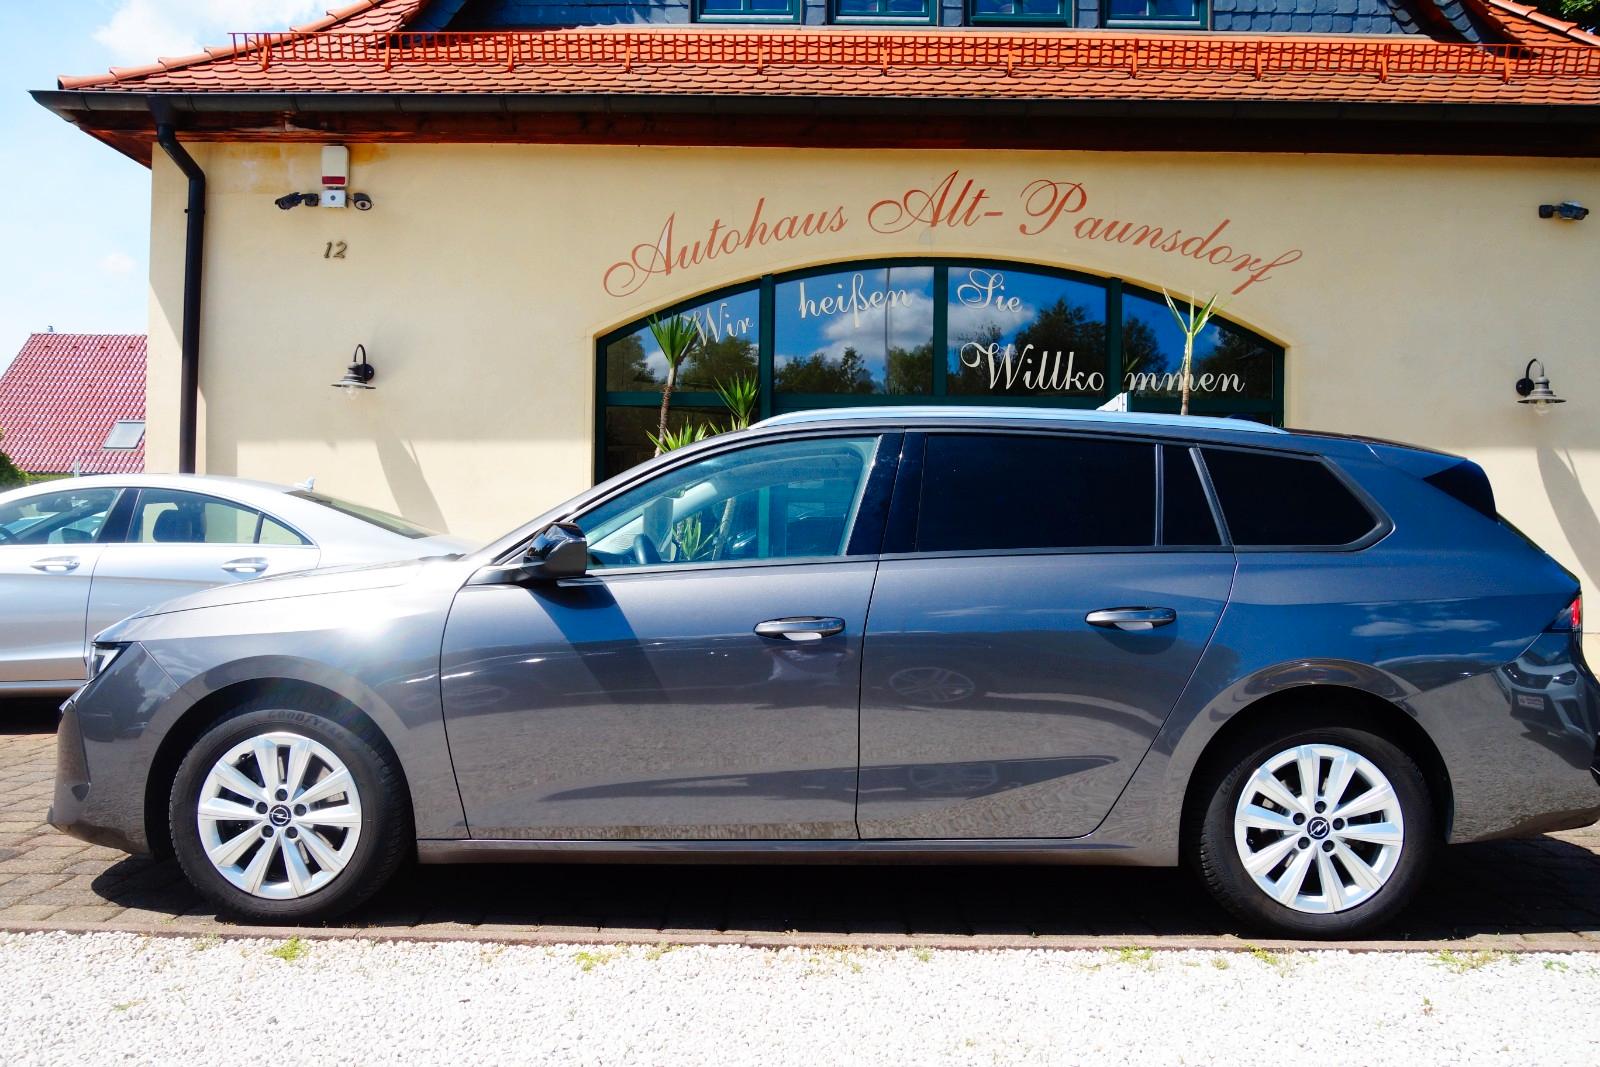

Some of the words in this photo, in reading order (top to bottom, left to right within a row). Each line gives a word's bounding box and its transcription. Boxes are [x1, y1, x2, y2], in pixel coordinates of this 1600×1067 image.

[323, 241, 348, 259] 12
[603, 197, 848, 298] Autohaus
[1019, 179, 1303, 295] Paunsdorf
[681, 302, 754, 347] Wir
[799, 273, 912, 329] heißen
[957, 269, 1023, 313] Sie
